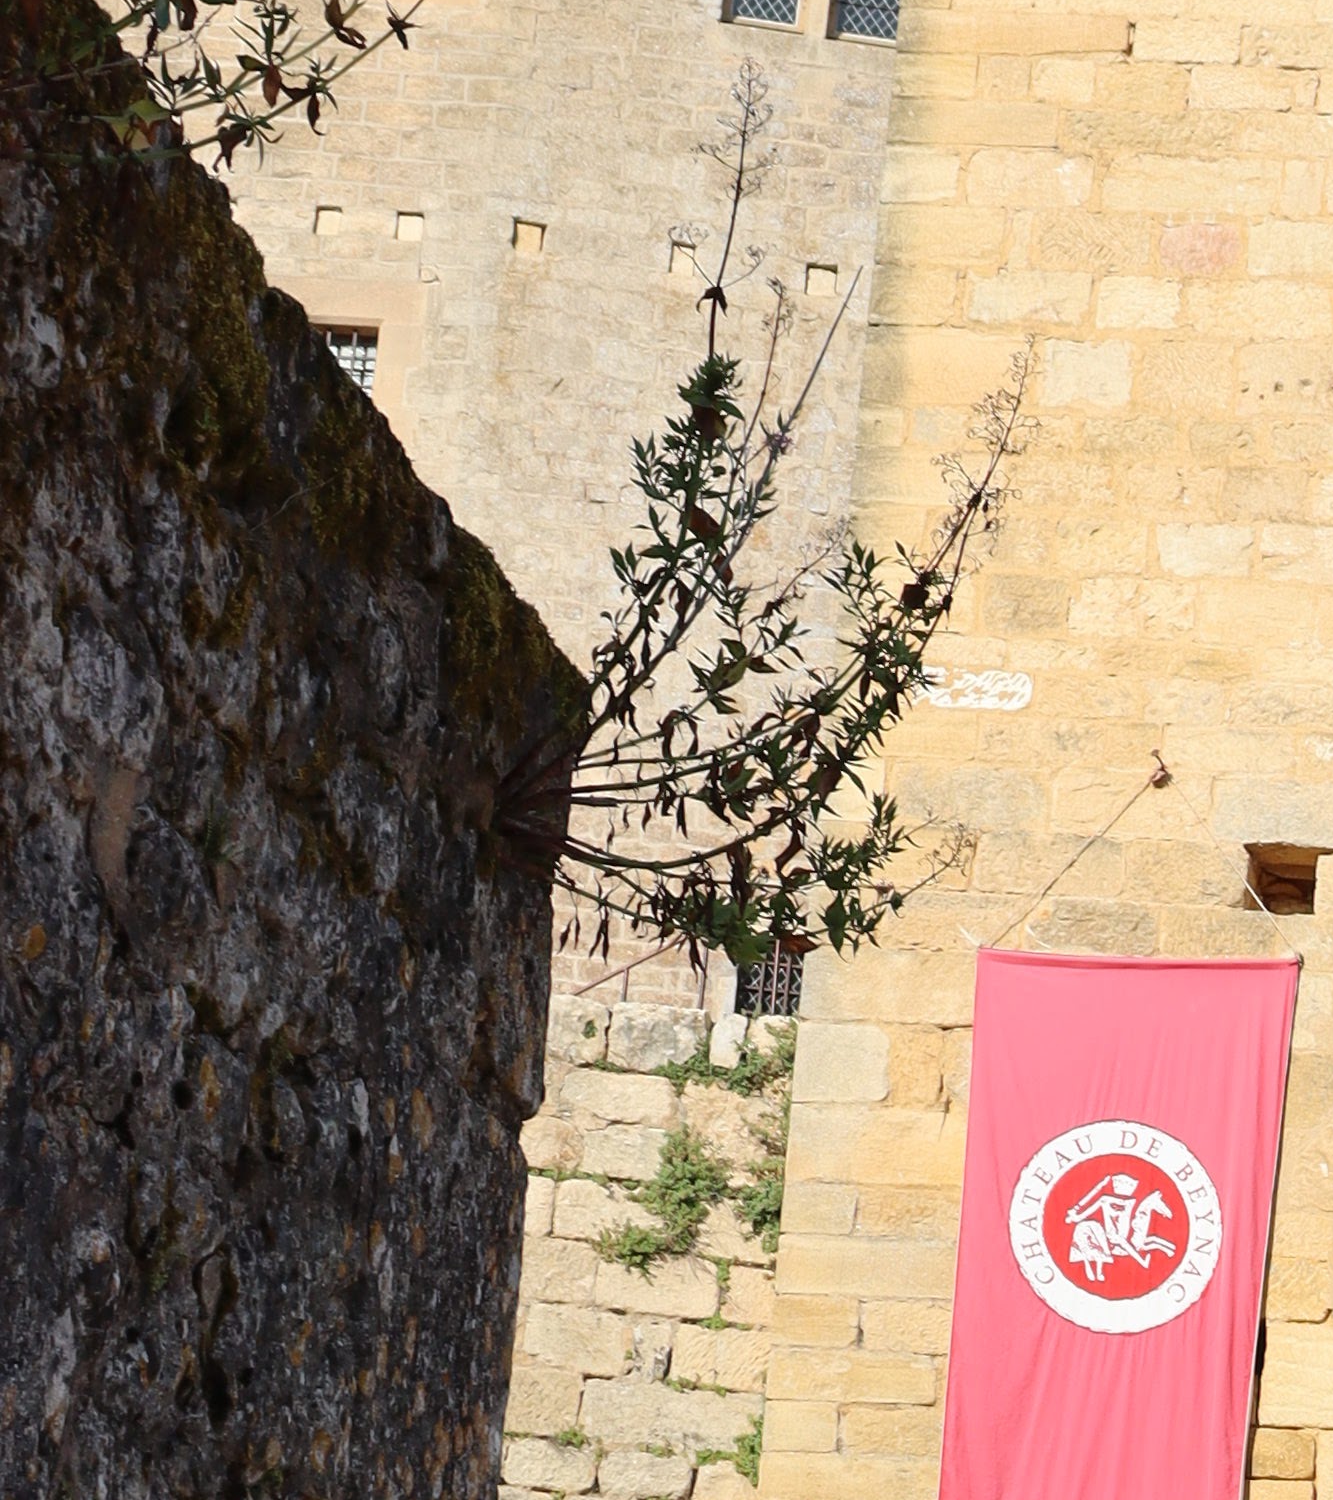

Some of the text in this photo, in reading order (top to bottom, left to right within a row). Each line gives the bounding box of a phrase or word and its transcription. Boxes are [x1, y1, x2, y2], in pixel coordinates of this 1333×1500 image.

[1019, 1131, 1215, 1303] CHATEAU DE BEYNAC
